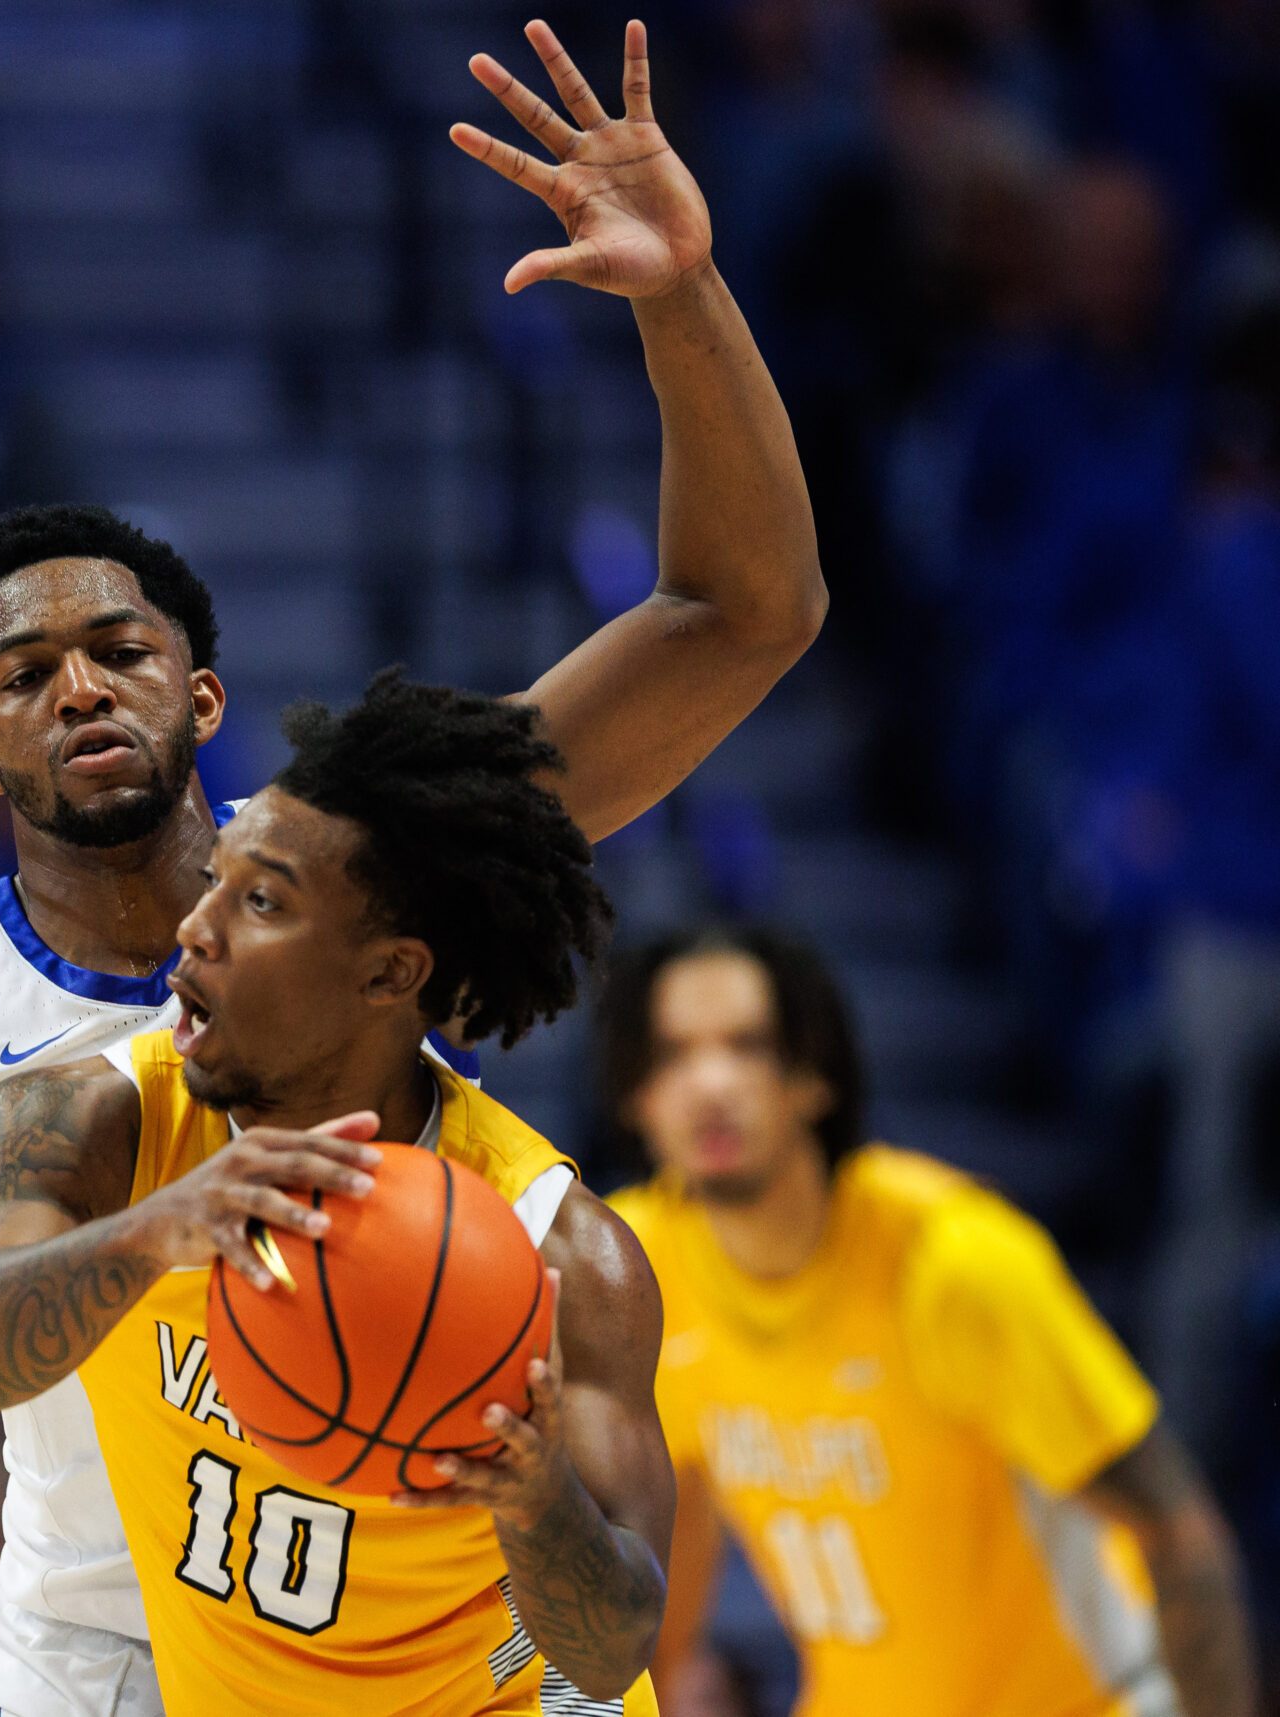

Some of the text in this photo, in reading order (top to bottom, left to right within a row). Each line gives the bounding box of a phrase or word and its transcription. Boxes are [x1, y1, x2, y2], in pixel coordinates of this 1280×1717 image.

[154, 1320, 254, 1447] VA
[175, 1448, 356, 1636] 10
[767, 1510, 884, 1642] 11
